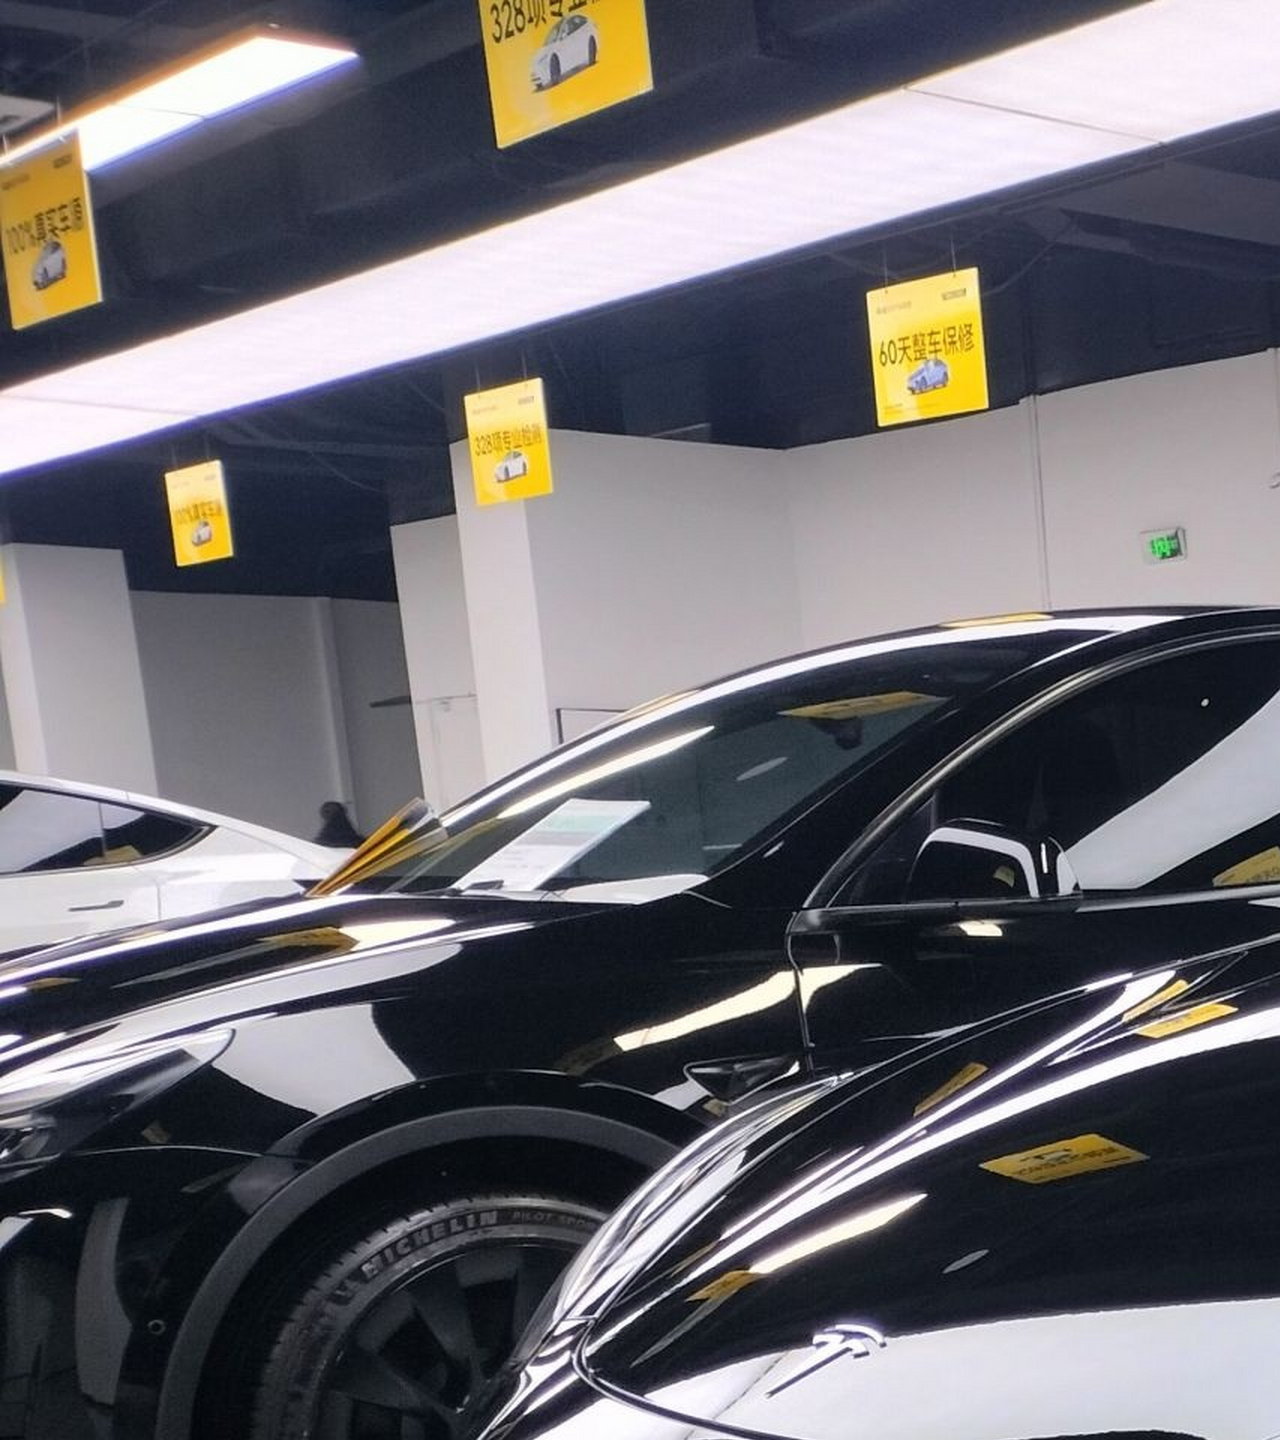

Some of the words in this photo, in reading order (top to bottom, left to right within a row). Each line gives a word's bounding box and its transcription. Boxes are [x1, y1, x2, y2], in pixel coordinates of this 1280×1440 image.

[878, 323, 976, 368] 60天整车保修
[360, 1209, 499, 1279] MICHELIN
